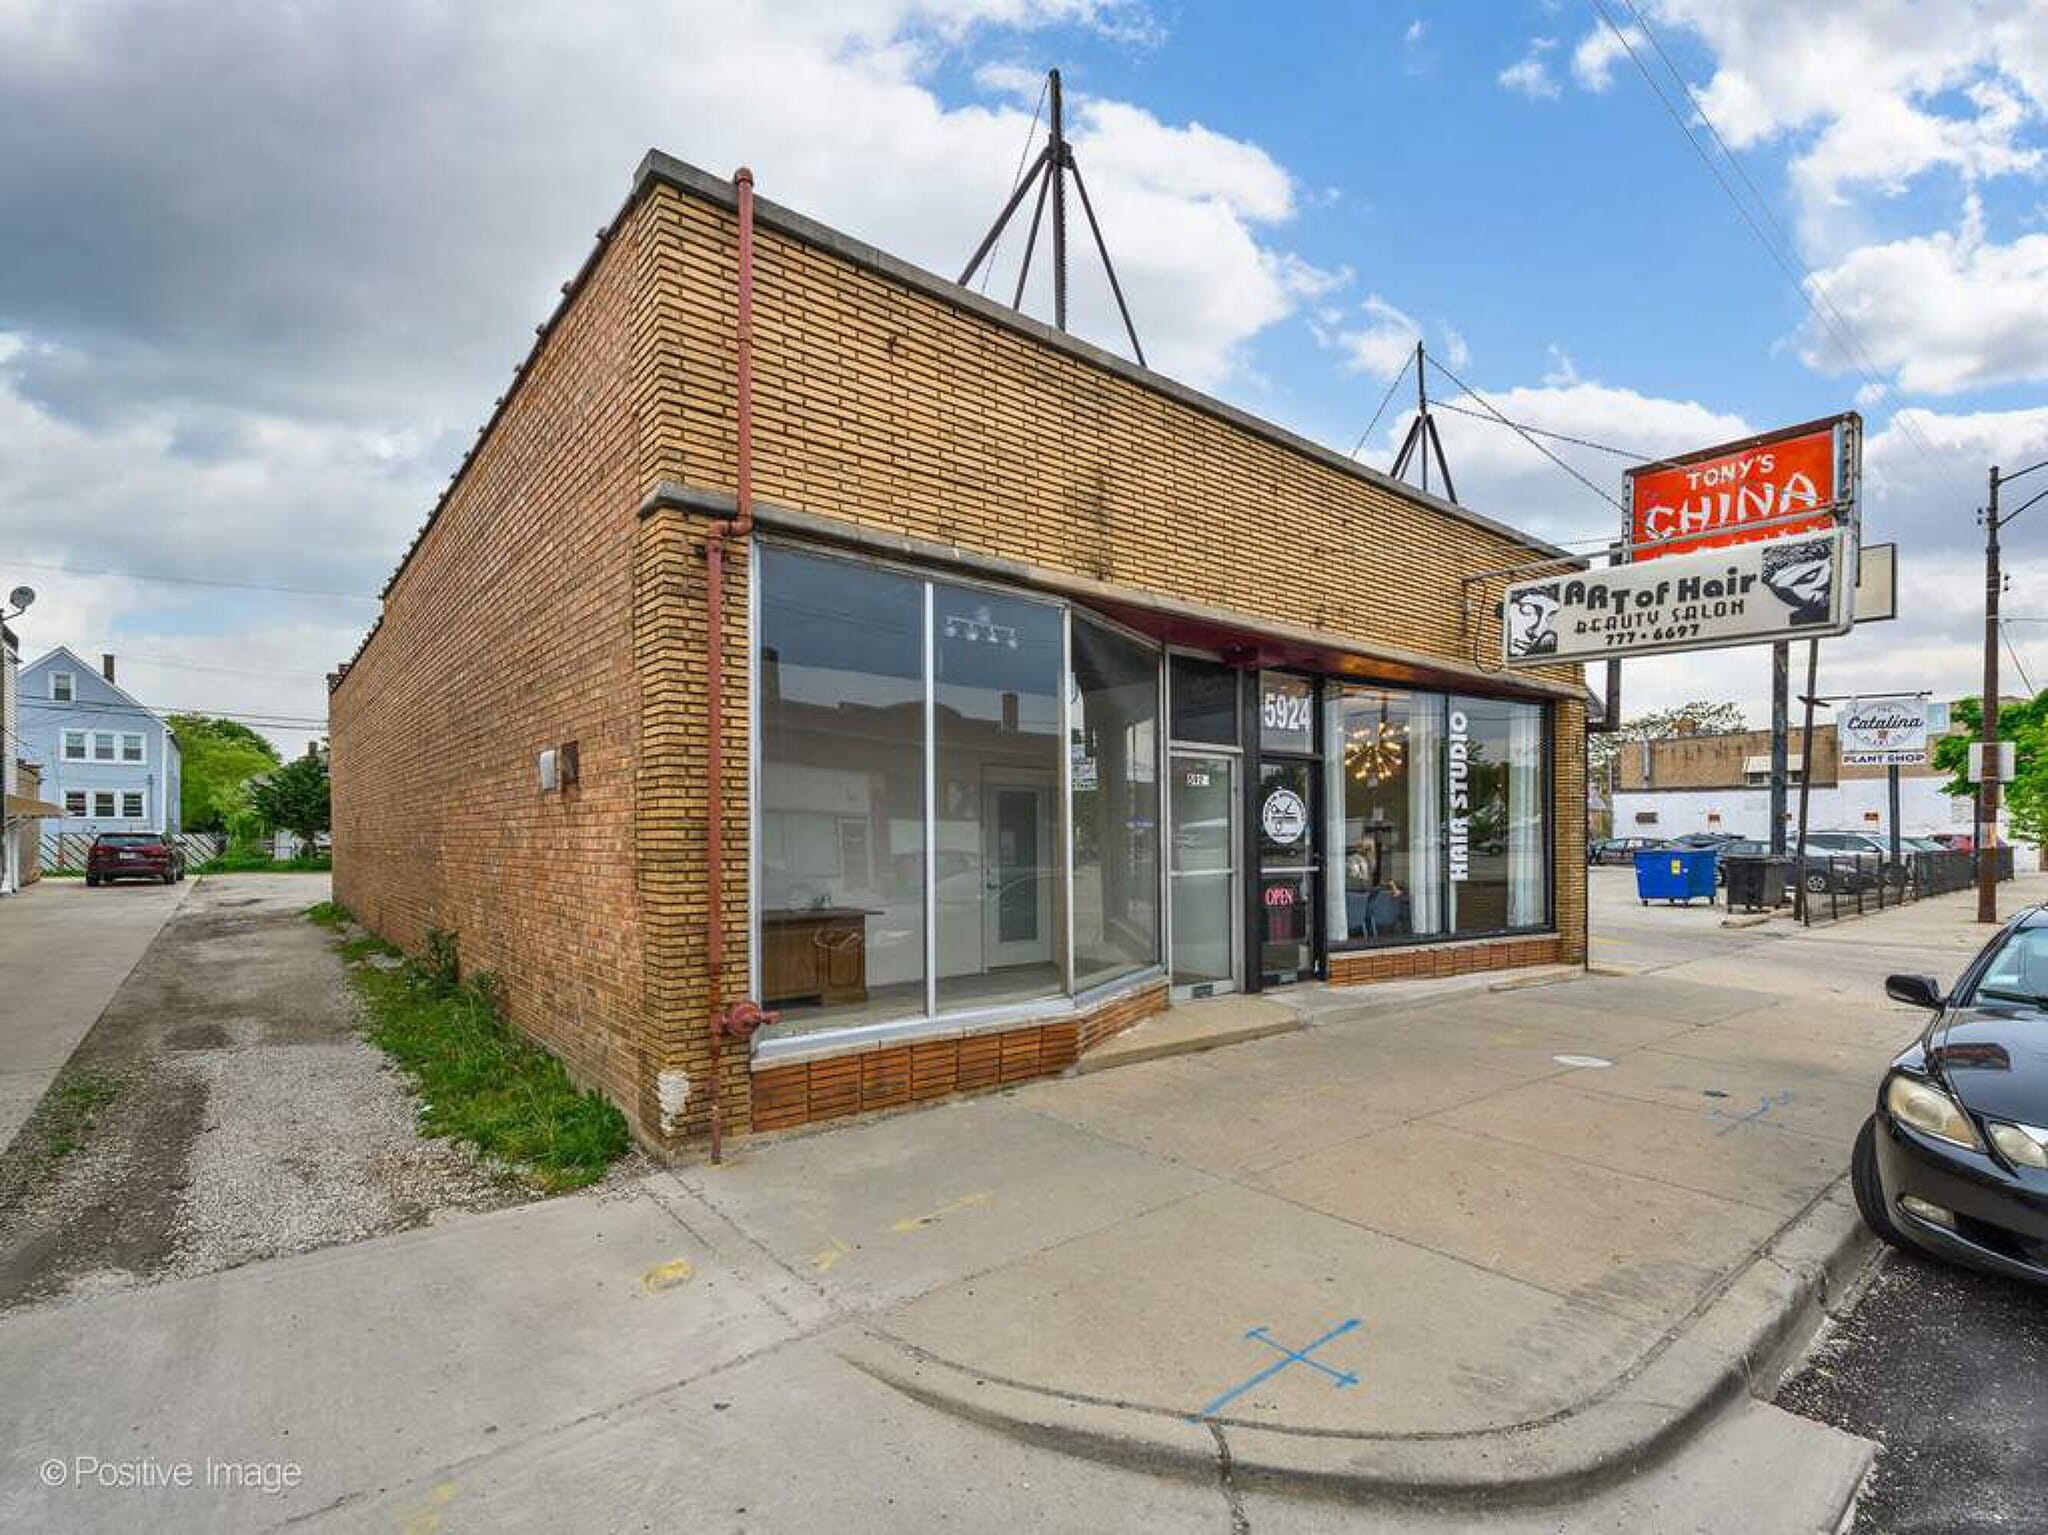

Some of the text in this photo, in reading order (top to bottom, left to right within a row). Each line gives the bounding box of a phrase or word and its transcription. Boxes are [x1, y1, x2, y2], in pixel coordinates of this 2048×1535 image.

[1686, 454, 1775, 490] TONY'S
[1645, 472, 1818, 540] CHINA
[1563, 566, 1757, 614] ART of Hair
[1671, 600, 1745, 623] SALON
[1264, 692, 1313, 732] 5924
[1847, 714, 1925, 730] Catalina
[1887, 754, 1925, 763] SHOP
[1450, 711, 1468, 881] HAIR STUDIO
[1265, 888, 1294, 905] OPEN
